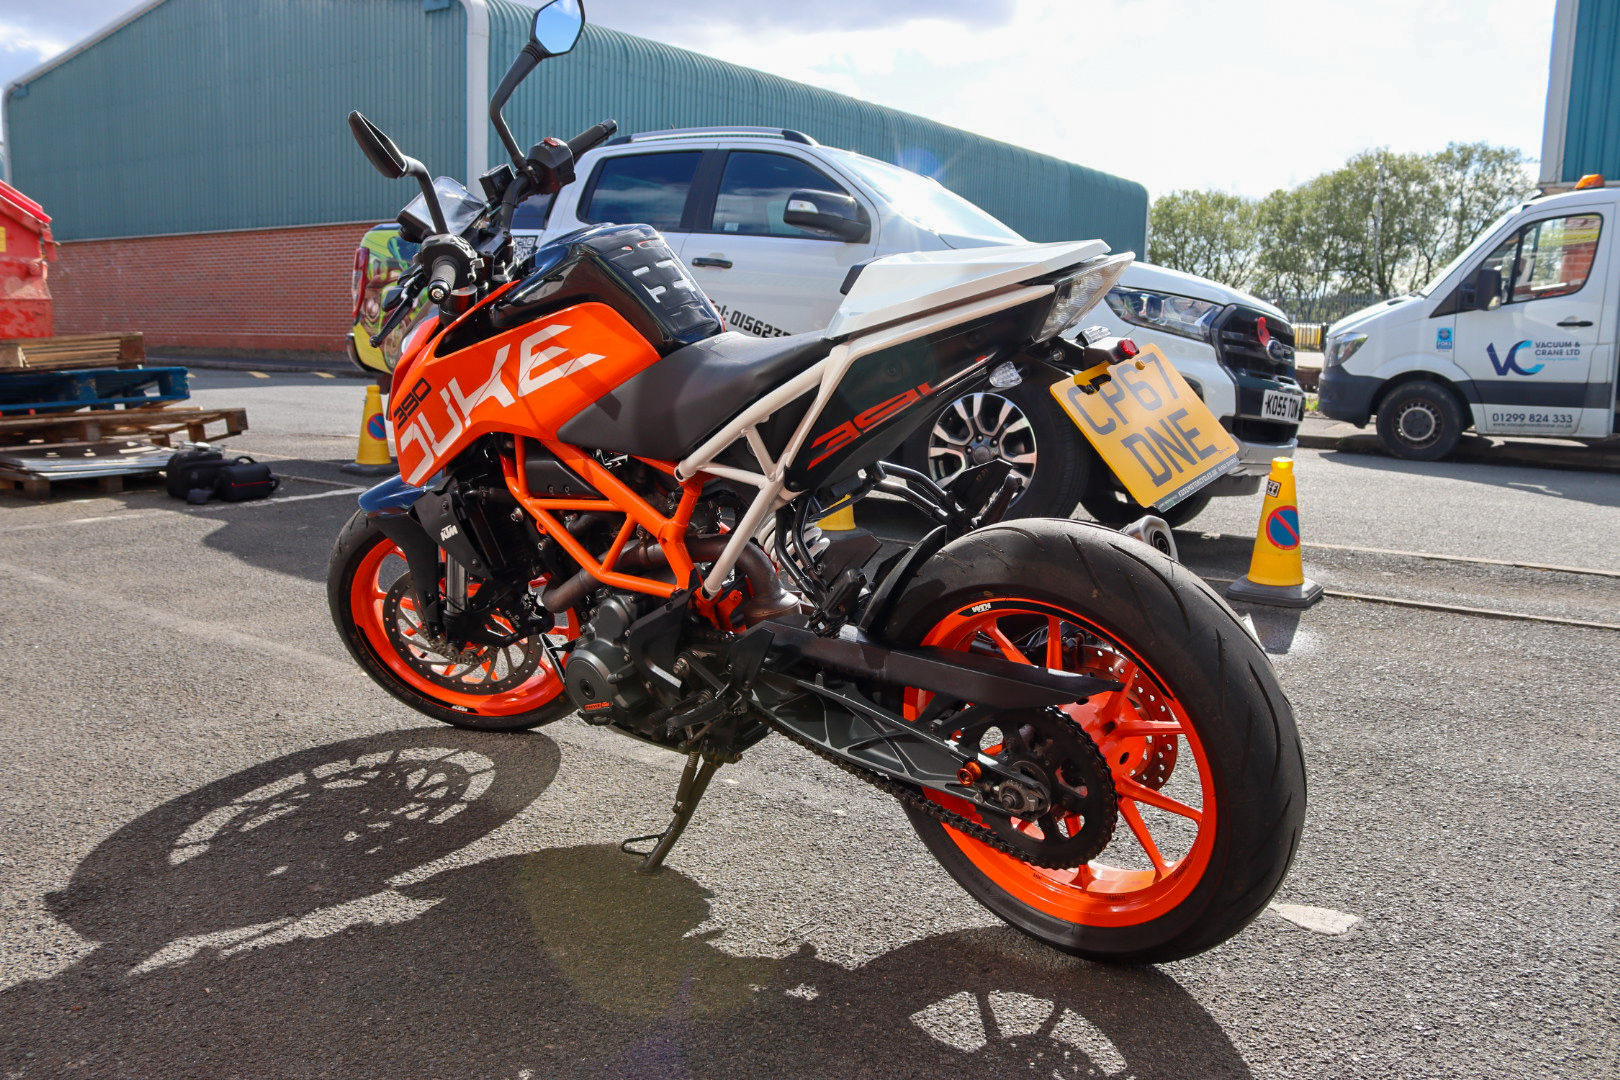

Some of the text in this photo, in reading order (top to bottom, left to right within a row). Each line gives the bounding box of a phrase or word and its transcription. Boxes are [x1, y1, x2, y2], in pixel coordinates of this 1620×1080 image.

[1487, 340, 1545, 376] VC
[394, 377, 432, 430] 390
[400, 324, 607, 487] DUKE
[1067, 352, 1178, 435] CP67
[1266, 395, 1288, 416] KO55
[1492, 413, 1573, 424] 01299 824 333
[1121, 408, 1218, 487] DNE
[440, 524, 458, 541] KTM
